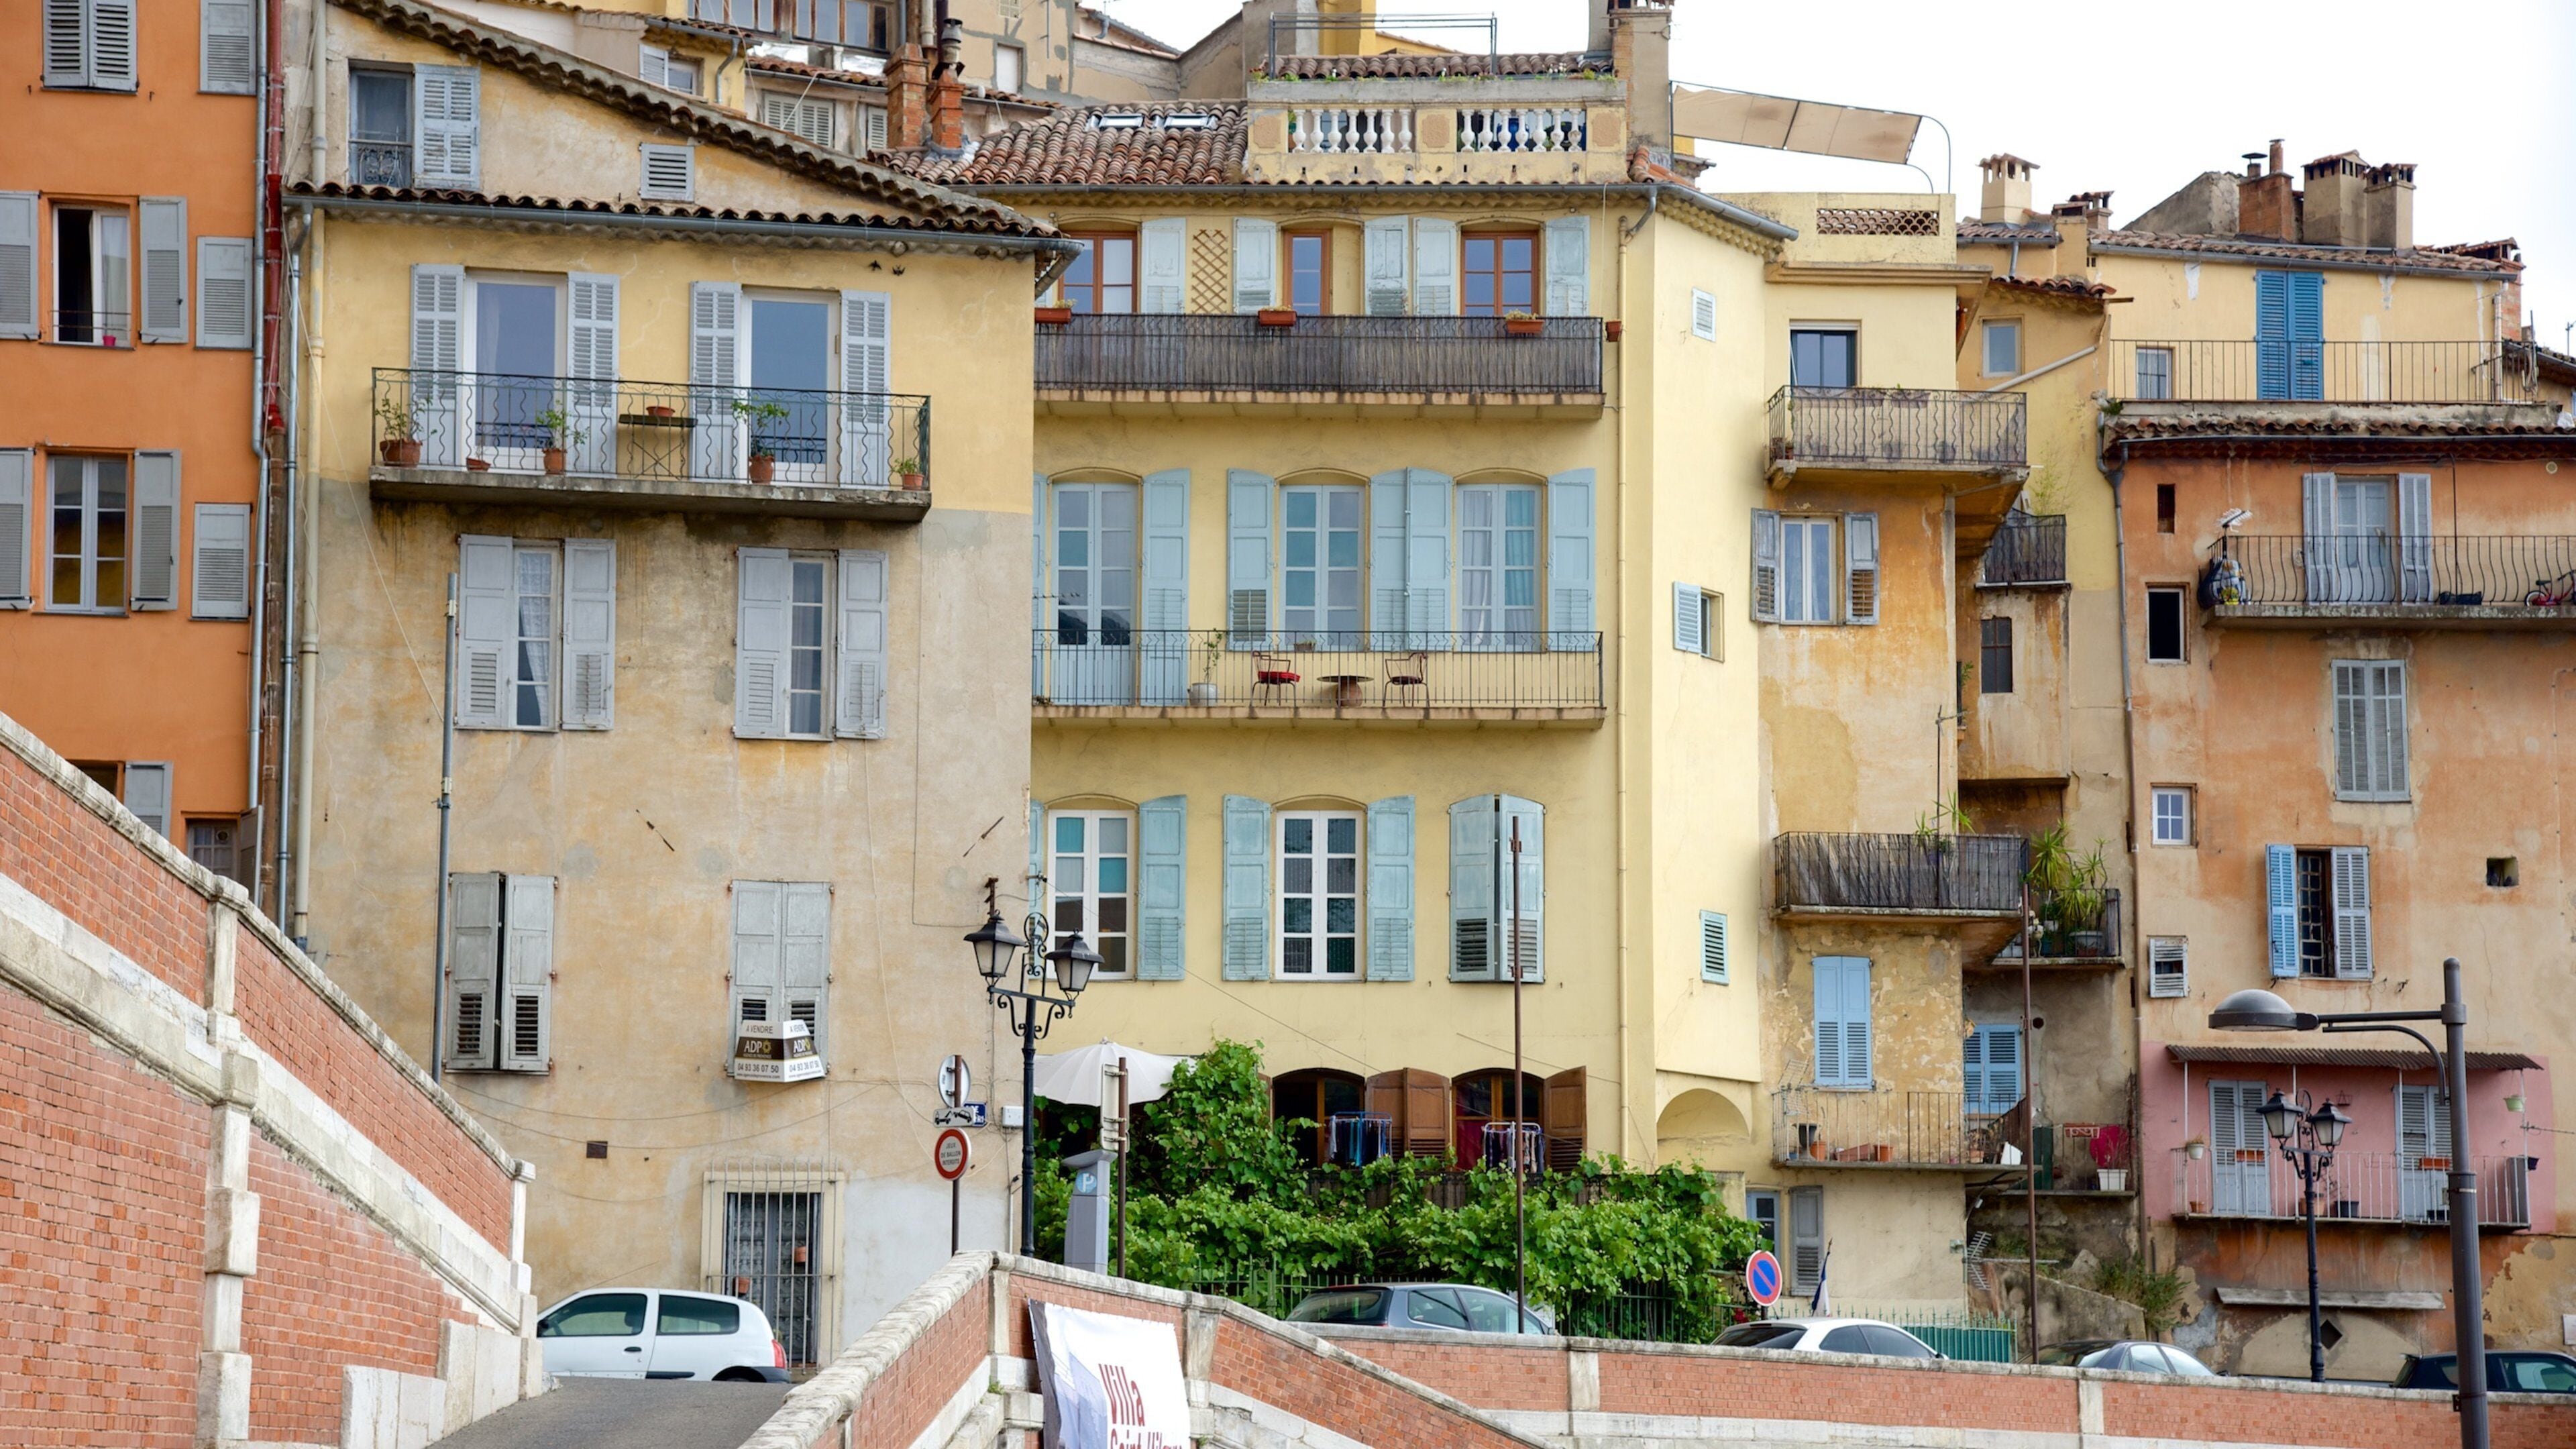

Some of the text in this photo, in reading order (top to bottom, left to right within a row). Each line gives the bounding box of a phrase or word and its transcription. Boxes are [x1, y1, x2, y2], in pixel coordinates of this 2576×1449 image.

[750, 1025, 773, 1034] VENDRE
[743, 1040, 763, 1053] ADP
[738, 1063, 780, 1073] 04 93 36 07 50
[790, 1064, 796, 1073] 04
[947, 1150, 961, 1158] BALLON
[1098, 1363, 1145, 1427] Villa
